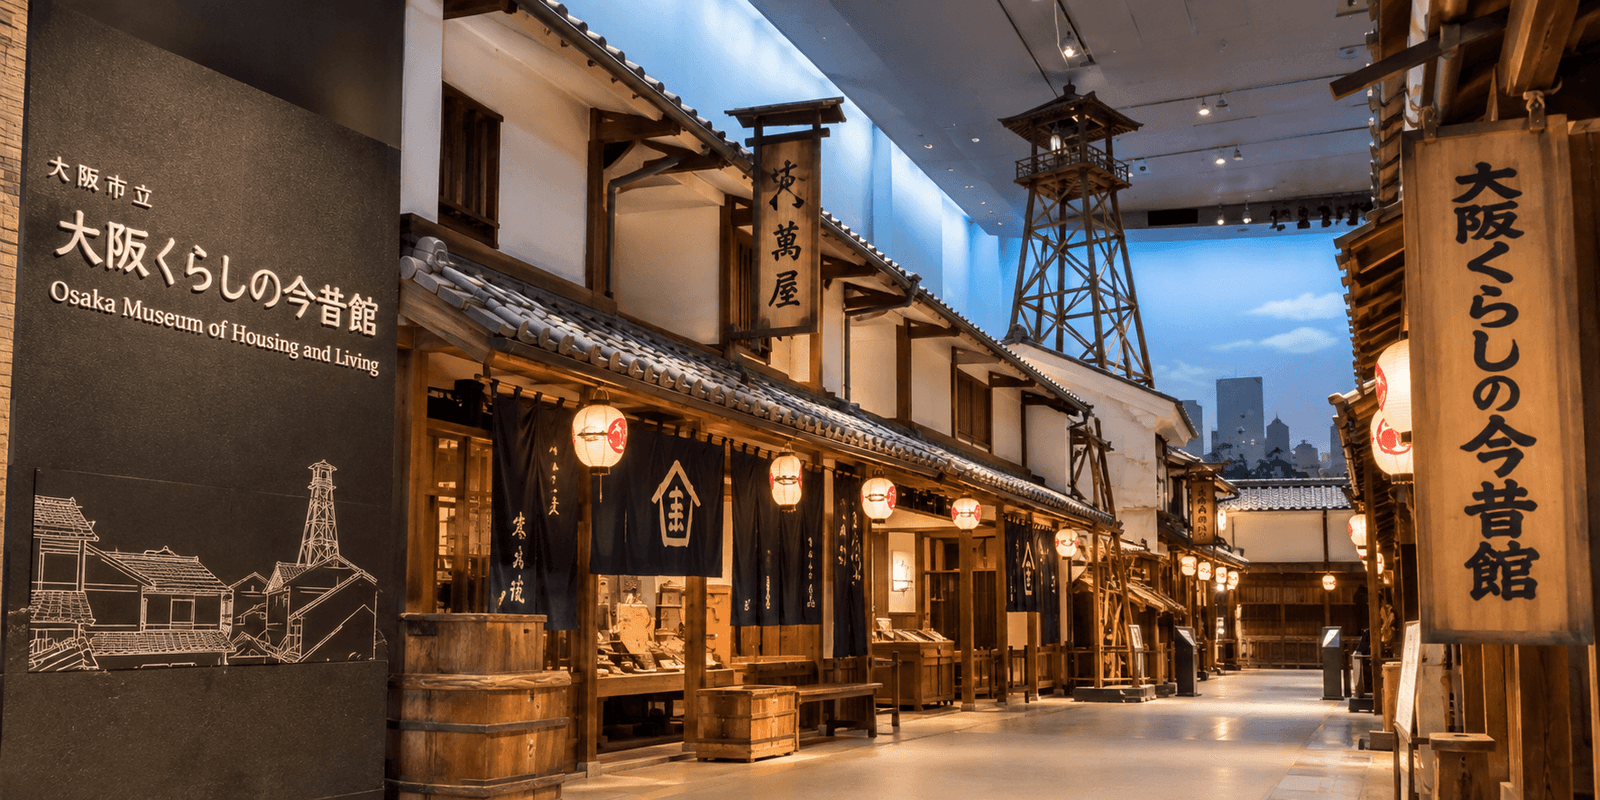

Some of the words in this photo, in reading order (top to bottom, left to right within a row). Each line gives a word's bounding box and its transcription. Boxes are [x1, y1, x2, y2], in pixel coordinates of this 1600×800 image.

[48, 156, 153, 207] 大阪市立
[50, 280, 117, 314] Osaka
[122, 297, 204, 334] Museum
[209, 320, 228, 339] of
[232, 324, 300, 359] Housing
[303, 344, 331, 363] and
[335, 348, 380, 378] Living
[54, 210, 379, 337] 大阪くらしの今昔館
[1452, 161, 1541, 600] 大阪くらしの今昔館
